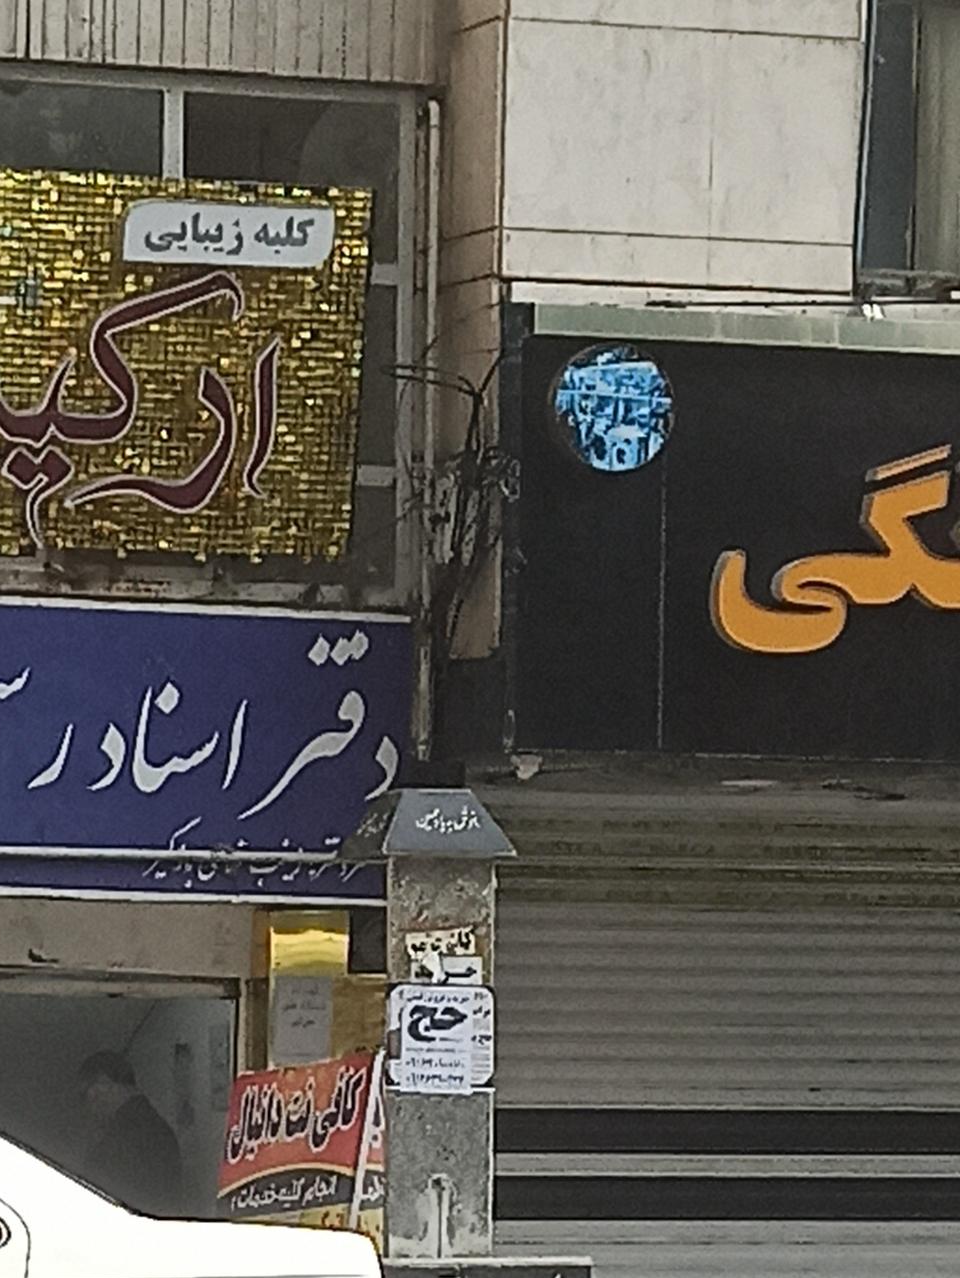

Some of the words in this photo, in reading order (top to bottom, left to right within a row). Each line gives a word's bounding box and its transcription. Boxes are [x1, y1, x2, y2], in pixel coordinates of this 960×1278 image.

[144, 212, 244, 255] زیبایی
[253, 216, 315, 254] کلبه
[709, 443, 960, 655] گی
[86, 681, 247, 793] اسناد
[236, 629, 401, 820] دفتر
